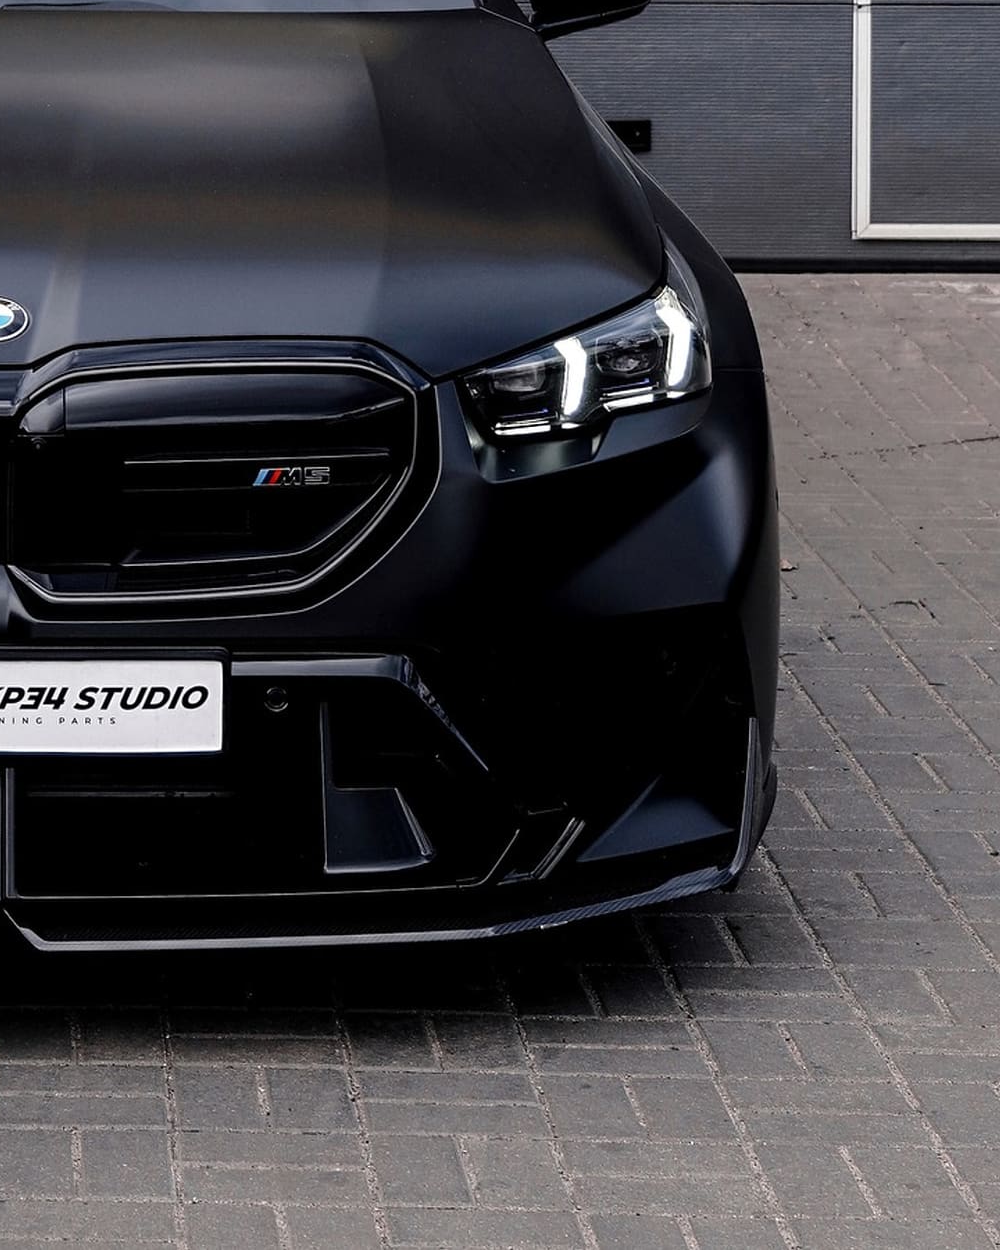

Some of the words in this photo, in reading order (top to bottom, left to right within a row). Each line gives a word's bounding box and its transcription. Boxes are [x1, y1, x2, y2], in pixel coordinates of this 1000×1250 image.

[278, 466, 330, 487] M5
[73, 686, 209, 711] STUDIO
[58, 716, 118, 725] PARTS
